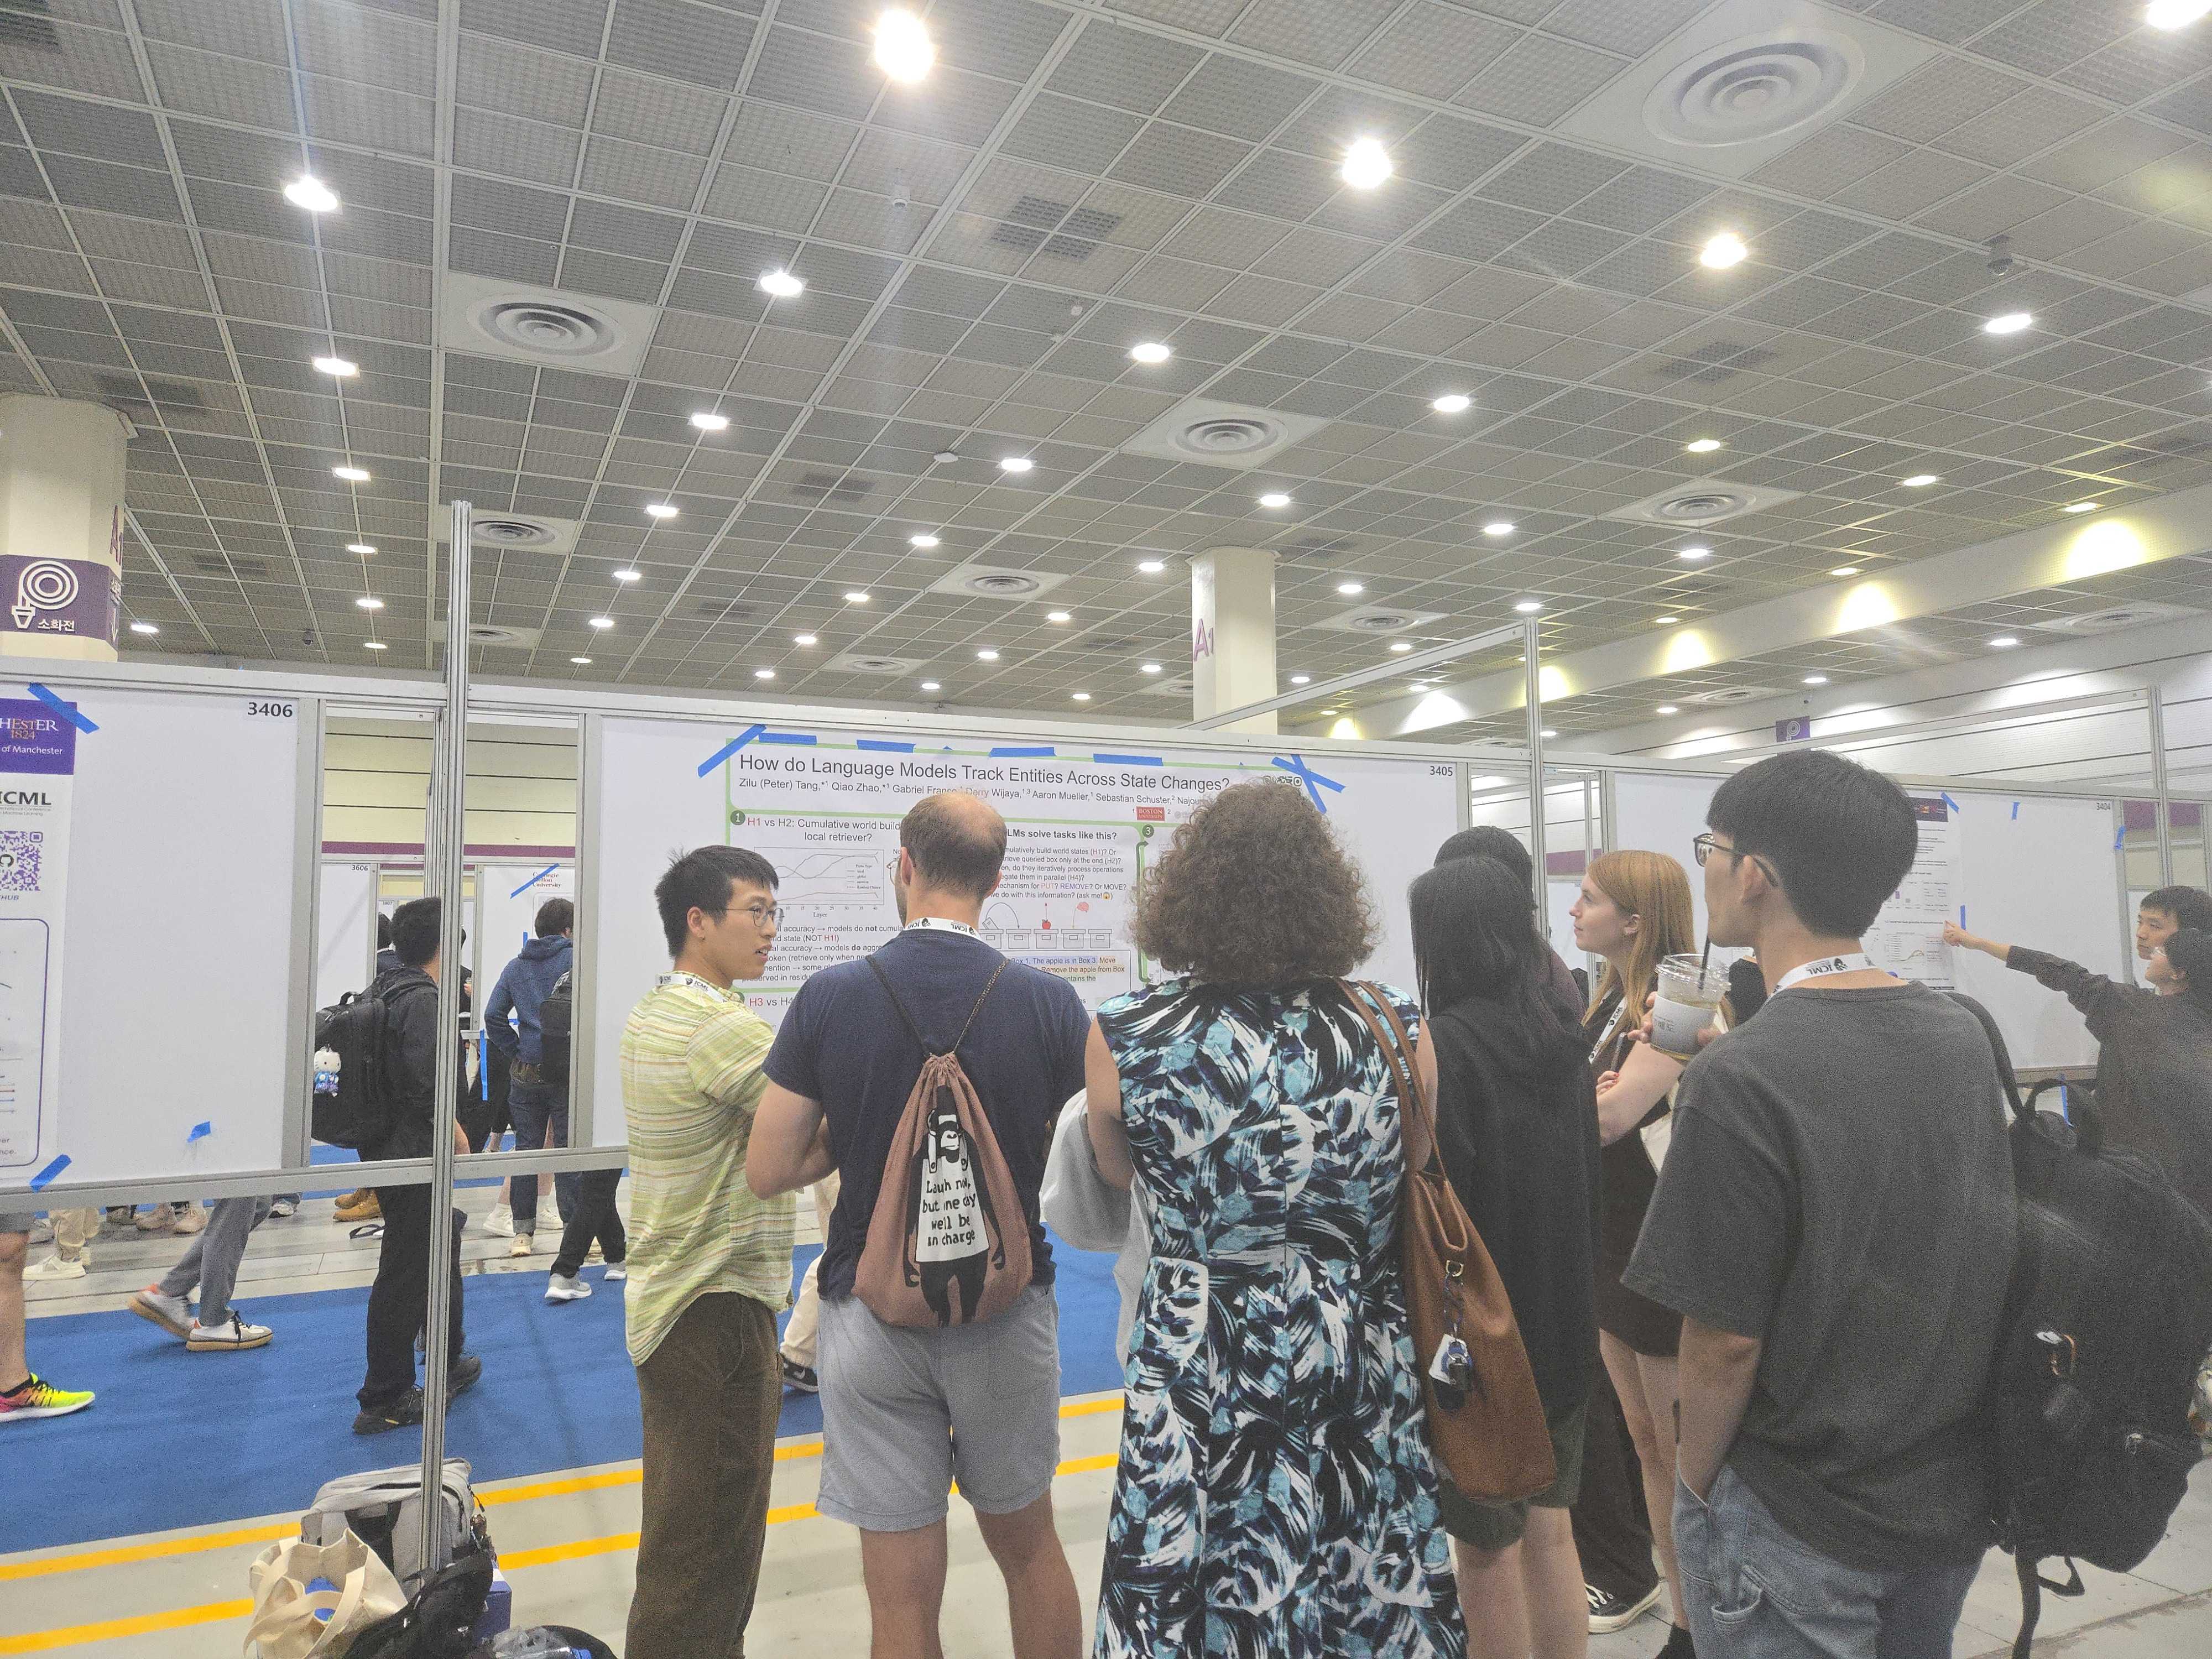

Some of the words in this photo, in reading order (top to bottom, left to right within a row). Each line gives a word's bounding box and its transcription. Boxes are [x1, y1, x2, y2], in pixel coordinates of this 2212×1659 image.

[37, 619, 75, 633] 소화전
[1193, 618, 1214, 661] A1
[247, 702, 293, 718] 3406
[12, 730, 35, 740] 1824
[12, 745, 63, 754] Manchester
[740, 754, 779, 770] How
[785, 757, 806, 772] do
[812, 758, 894, 779] Language
[900, 762, 956, 779] Models
[962, 765, 1004, 781] Track
[1009, 767, 1063, 784] Entities
[1067, 770, 1115, 786] Across
[1121, 773, 1156, 789] State
[1161, 775, 1230, 793] Changes?
[1430, 766, 1453, 777] 3405
[739, 778, 757, 787] Zilu
[760, 779, 792, 789] (Peter)
[831, 782, 853, 792] Qiao
[893, 784, 924, 794] Gabriel
[1032, 791, 1057, 799] Aaron
[1096, 794, 1134, 802] Sebastian
[735, 813, 740, 822] 1
[748, 817, 760, 826] H1
[778, 819, 794, 827] H2:
[797, 819, 849, 829] Cumulative
[852, 820, 877, 830] world
[1096, 832, 1117, 840] this?
[1146, 827, 1151, 835] 3
[805, 832, 826, 841] local
[829, 833, 873, 842] retriever?
[1022, 865, 1036, 873] they
[951, 923, 967, 932] ICML
[1806, 964, 1832, 974] ICML
[694, 980, 708, 991] ICML
[749, 998, 763, 1006] H3
[922, 1199, 940, 1213] but
[943, 1198, 960, 1211] ne
[958, 1213, 971, 1227] be
[927, 1237, 938, 1246] in
[942, 1229, 975, 1246] charge
